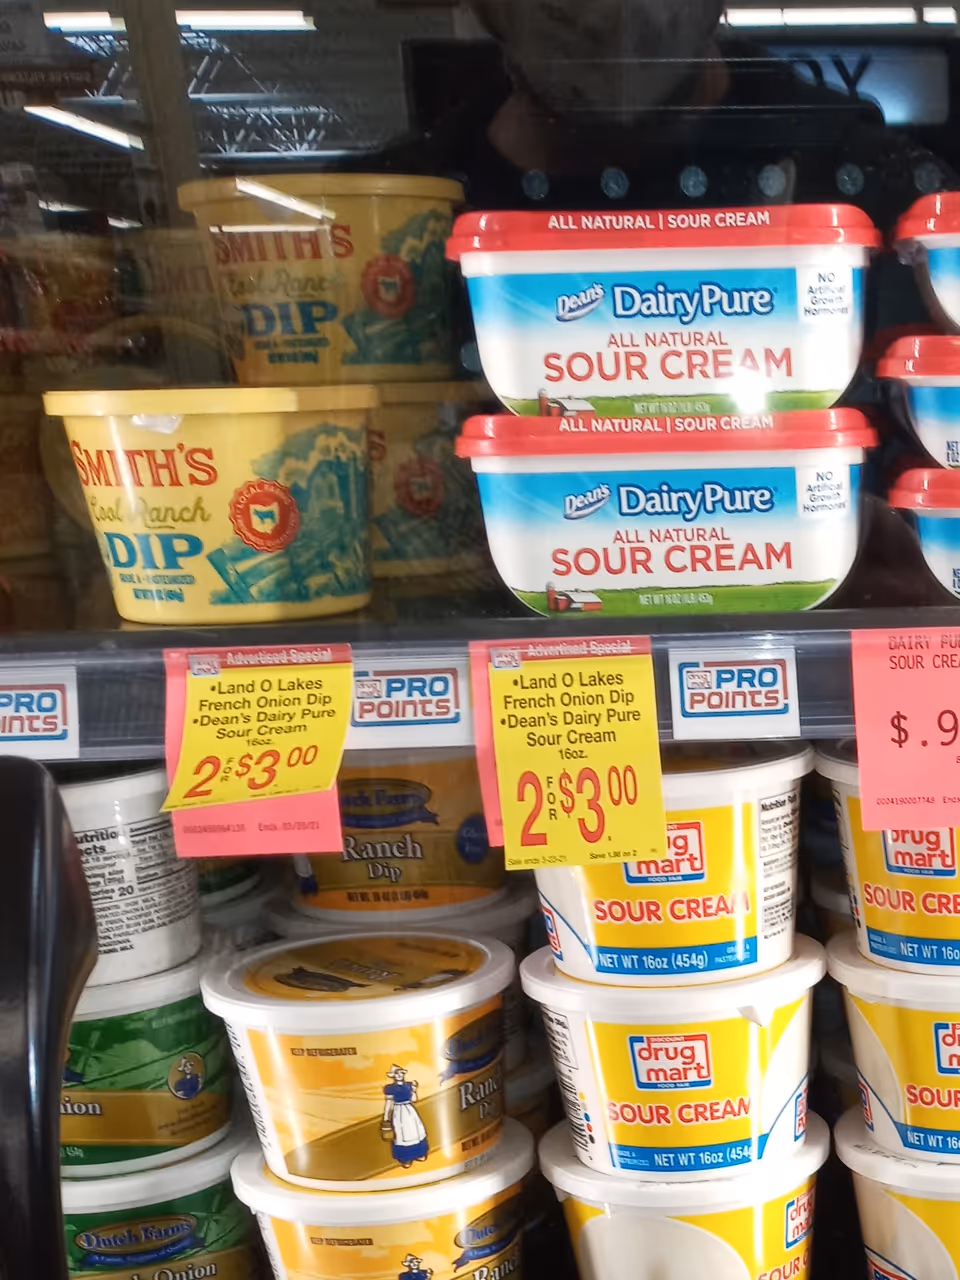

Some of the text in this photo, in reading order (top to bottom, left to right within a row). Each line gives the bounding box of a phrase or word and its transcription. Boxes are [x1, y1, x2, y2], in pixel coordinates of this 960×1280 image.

[548, 212, 770, 229] ALL NATURAL SOUR CREAM
[818, 272, 835, 284] NO
[608, 332, 728, 348] ALL NATURAL
[544, 348, 793, 383] SOUR CREAM
[70, 440, 218, 487] SMITH'S
[105, 533, 204, 570] DIP
[552, 542, 793, 577] SOUR CREAM
[888, 635, 932, 651] DAIRY
[889, 655, 925, 670] SOUR
[563, 673, 574, 686] O
[579, 671, 623, 686] Lakes
[716, 667, 778, 688] PRO
[503, 690, 634, 710] French Onion Dip
[689, 688, 779, 710] POINTS
[563, 710, 601, 727] Dairy
[606, 708, 641, 723] Pure
[526, 728, 617, 747] Sour Cream
[517, 770, 548, 847] 2
[341, 834, 423, 861] Ranch
[368, 863, 401, 881] Dip
[863, 883, 915, 913] SOUR
[594, 898, 661, 923] SOUR
[599, 950, 708, 971] NET WT 16oz (454g)
